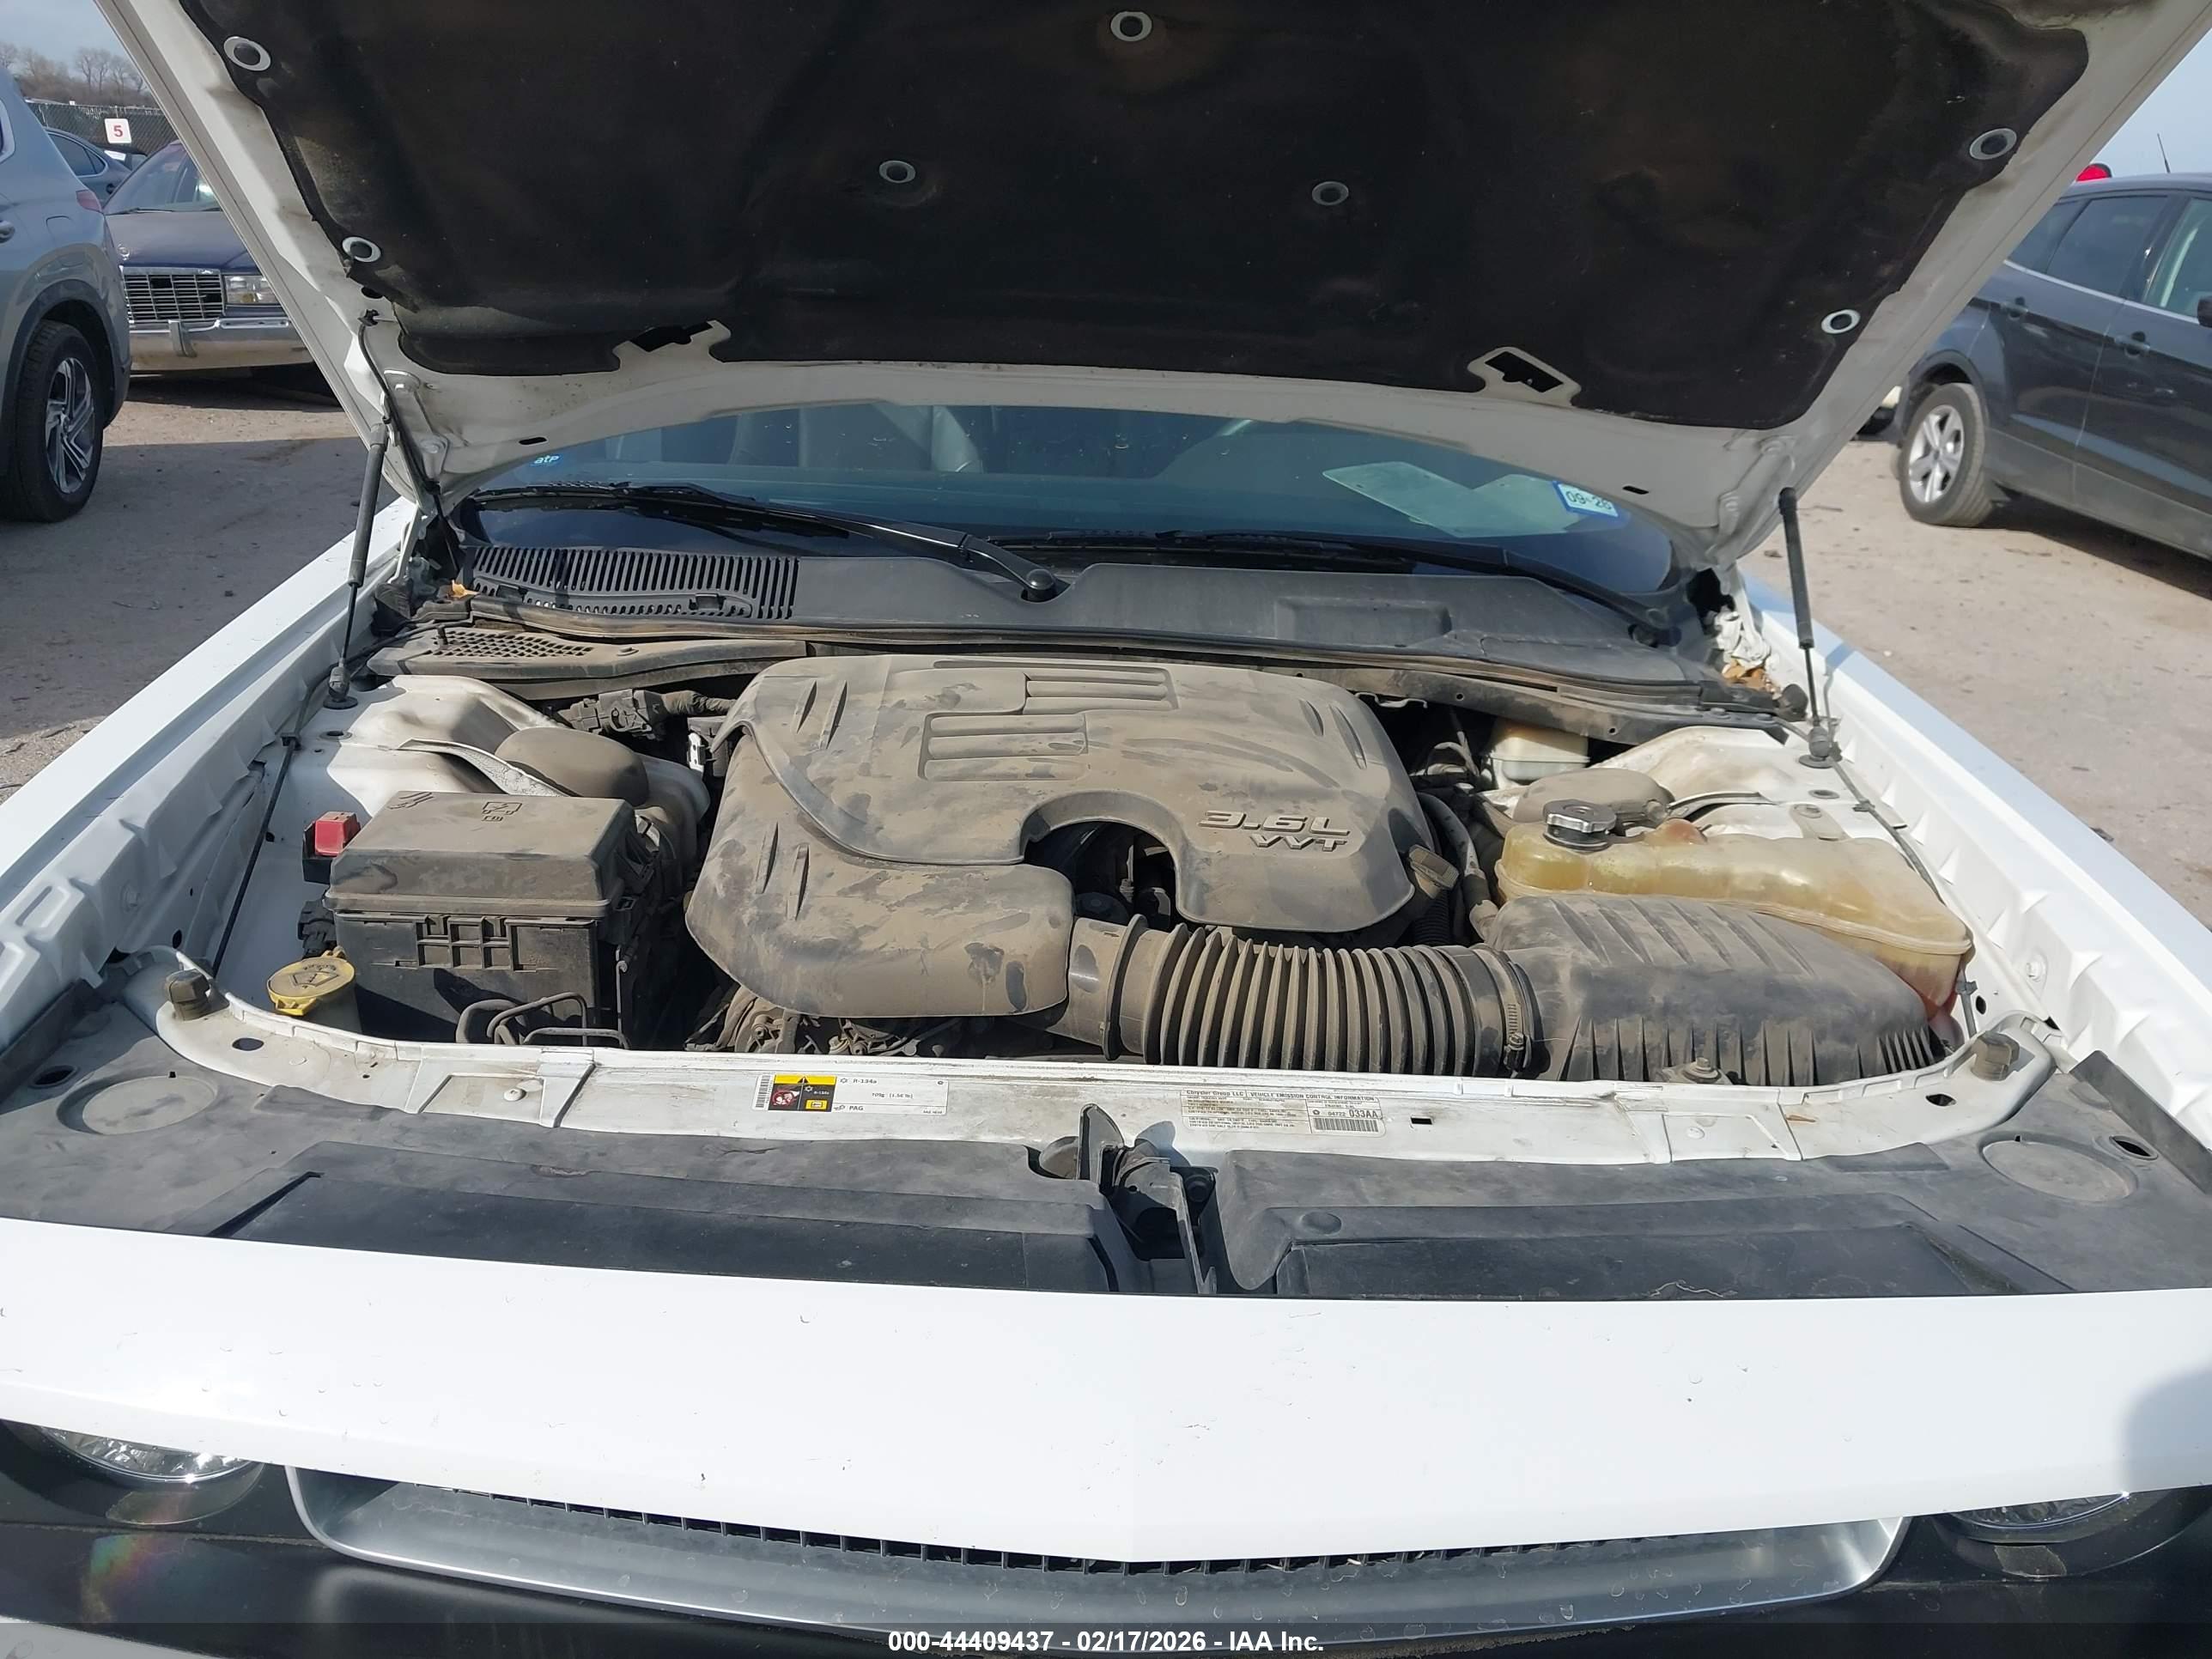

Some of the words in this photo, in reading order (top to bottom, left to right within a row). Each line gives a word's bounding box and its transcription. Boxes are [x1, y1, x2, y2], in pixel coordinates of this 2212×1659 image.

[113, 125, 124, 137] 5
[1199, 810, 1351, 836] 3.6L
[1249, 833, 1348, 852] VVT
[1349, 1109, 1378, 1118] 033AA
